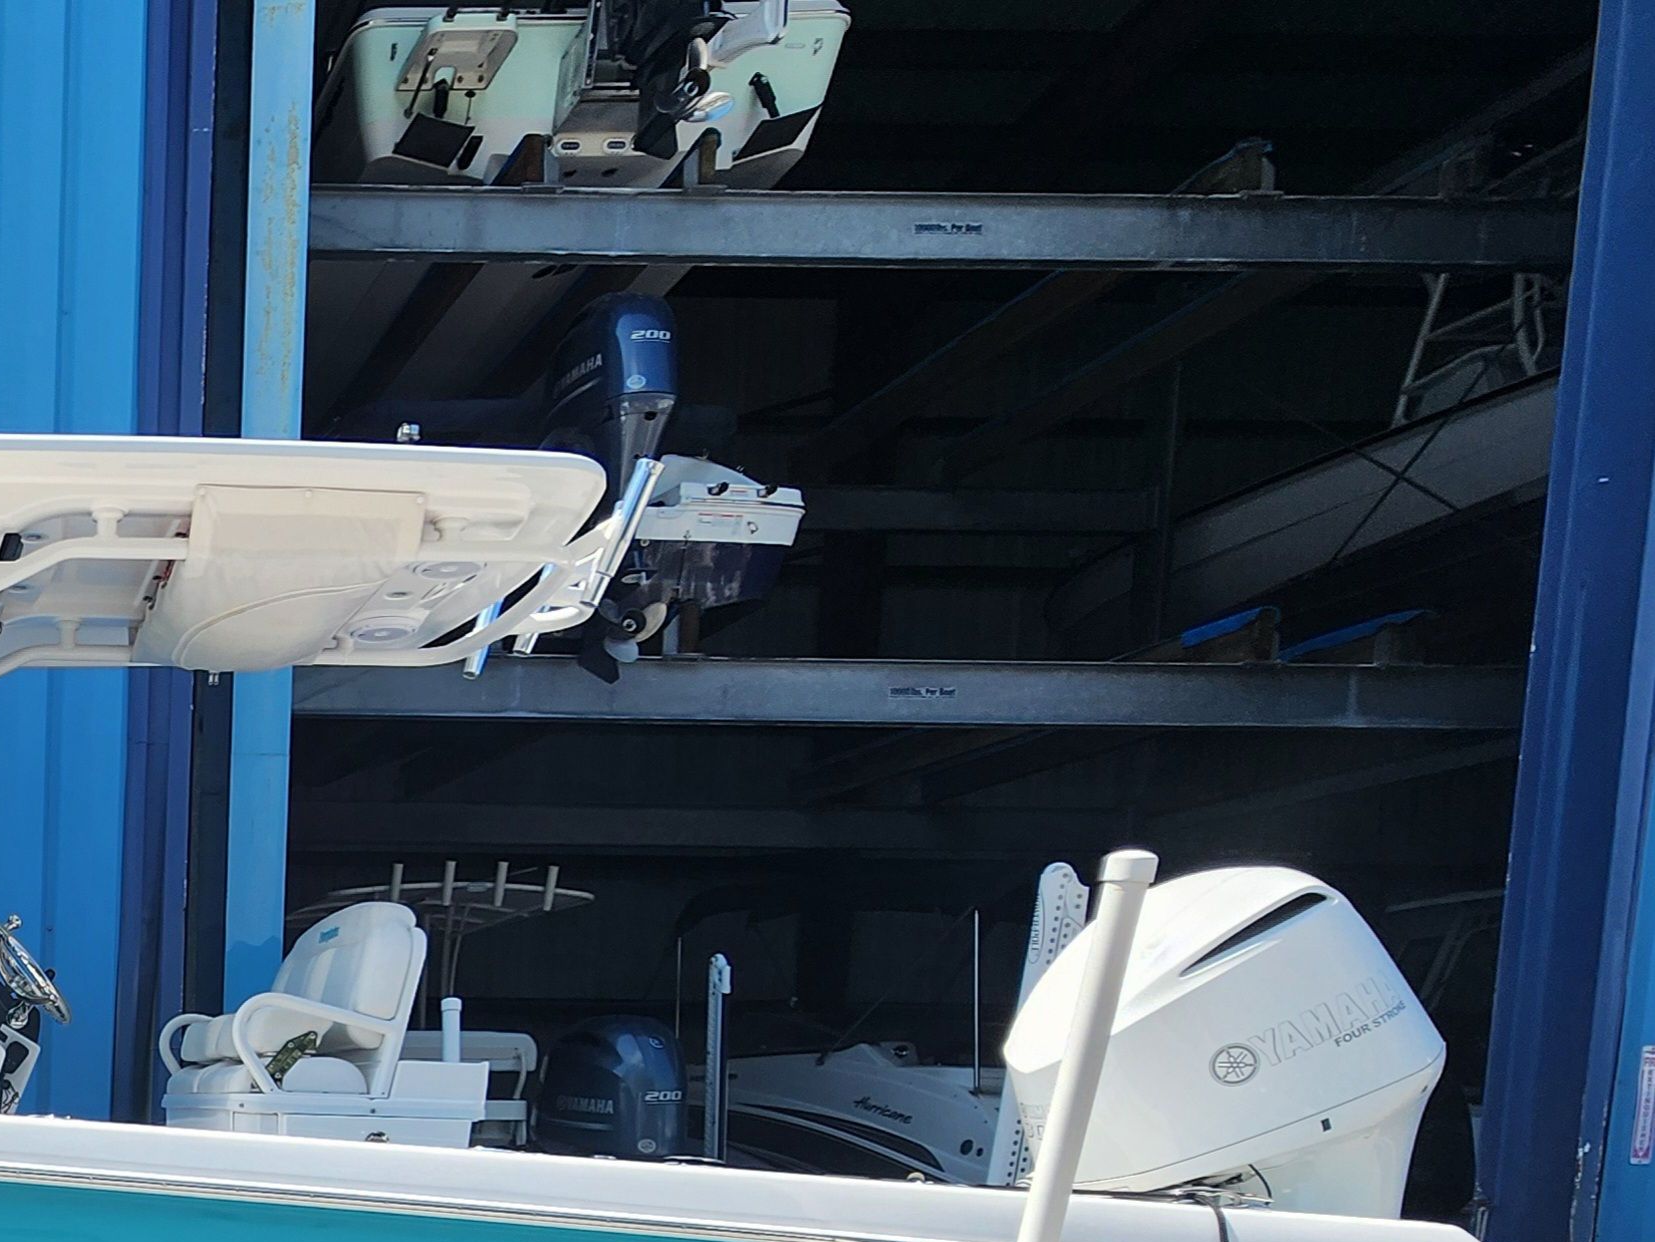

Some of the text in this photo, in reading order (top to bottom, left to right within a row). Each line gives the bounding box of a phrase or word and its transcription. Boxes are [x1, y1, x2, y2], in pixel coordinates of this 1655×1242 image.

[630, 329, 672, 341] 200
[1333, 999, 1407, 1048] FOUR STROKE
[567, 1095, 615, 1116] YAMAHA
[644, 1090, 683, 1102] 200
[852, 1095, 913, 1125] Hurricane
